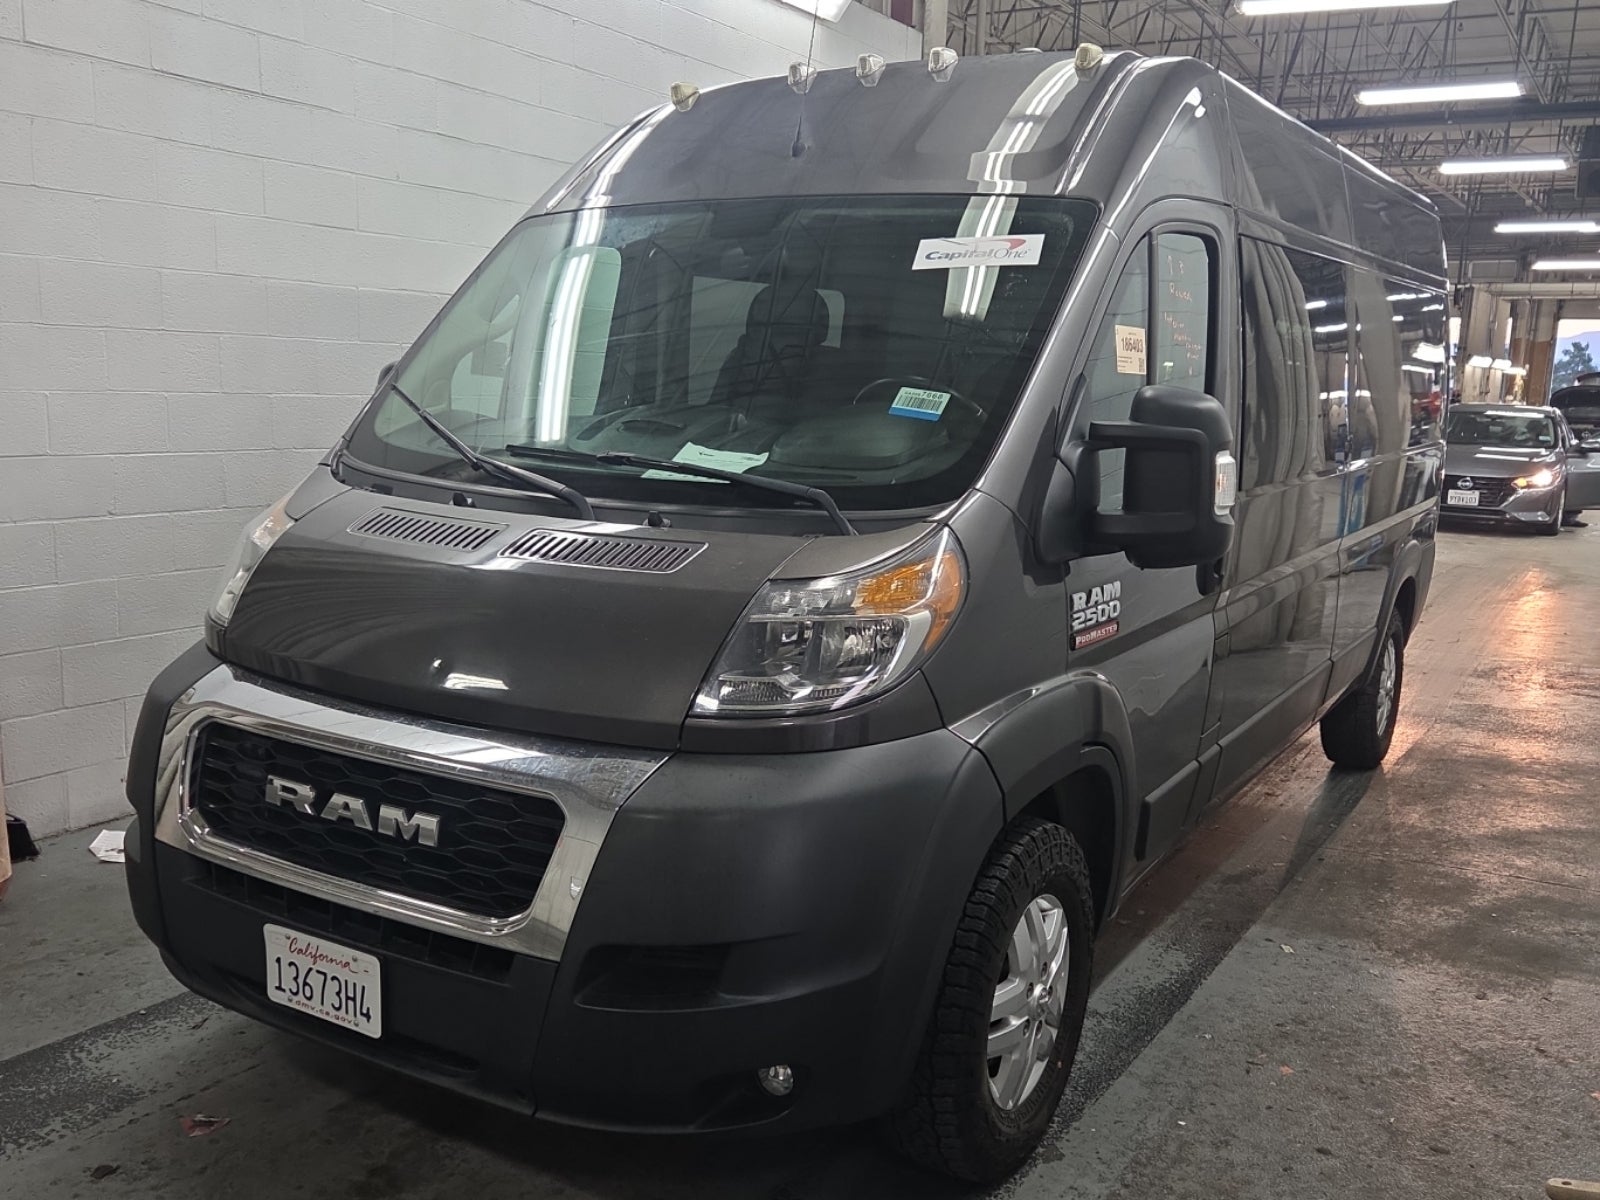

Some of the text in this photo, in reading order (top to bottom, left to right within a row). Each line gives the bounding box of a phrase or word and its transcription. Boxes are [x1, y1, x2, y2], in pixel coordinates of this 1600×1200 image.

[1071, 580, 1121, 612] RAM
[1071, 600, 1121, 632] 2500
[265, 774, 441, 847] RAM
[288, 937, 359, 974] California
[274, 956, 372, 1024] 13673H4
